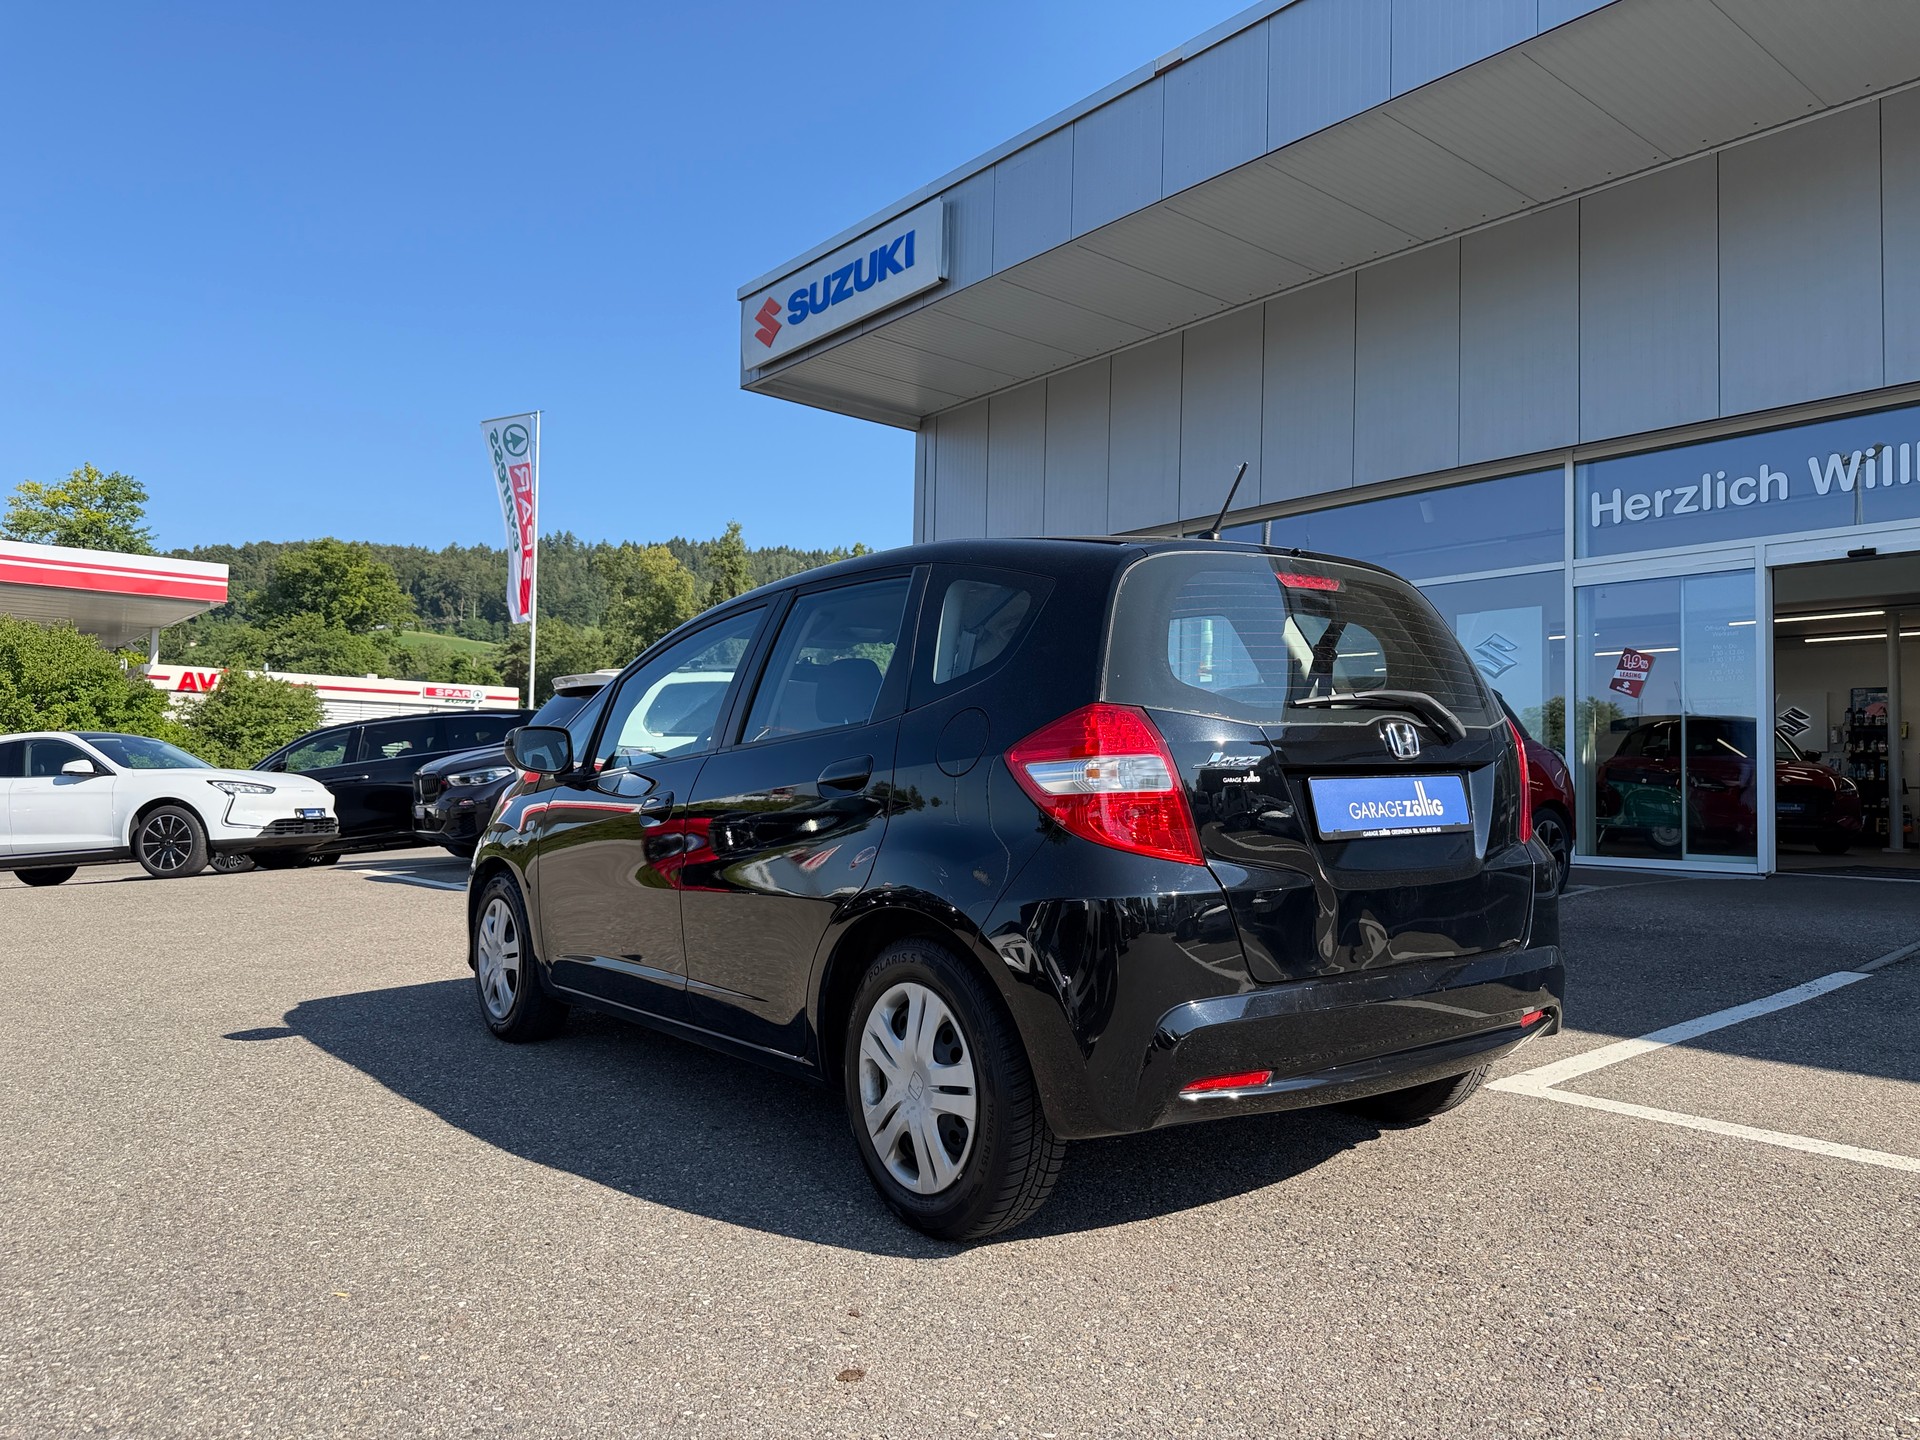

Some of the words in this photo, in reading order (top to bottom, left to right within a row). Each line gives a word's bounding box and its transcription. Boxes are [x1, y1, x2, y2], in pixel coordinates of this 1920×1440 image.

[787, 230, 916, 326] SUZUKI
[1591, 464, 1789, 528] Herzlich
[1808, 441, 1920, 495] Will
[177, 670, 222, 691] AV
[435, 688, 470, 698] SPAR
[868, 953, 907, 982] POLARIS
[986, 1103, 994, 1143] 175/65
[982, 1145, 991, 1167] R15
